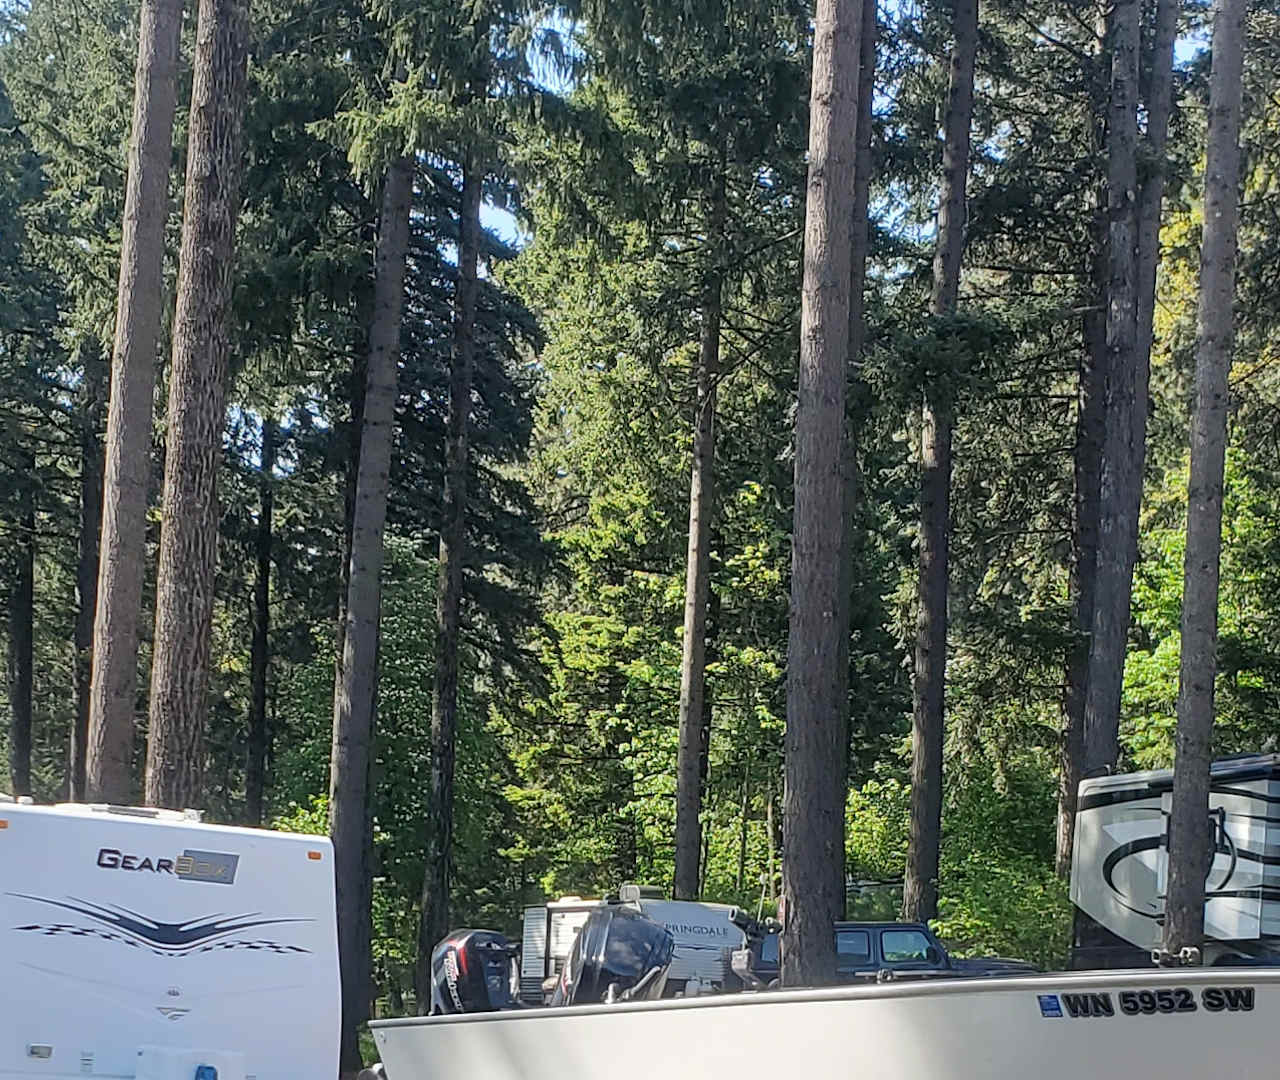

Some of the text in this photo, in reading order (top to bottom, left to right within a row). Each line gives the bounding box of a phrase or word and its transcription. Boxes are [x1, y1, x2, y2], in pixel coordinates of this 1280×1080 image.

[664, 922, 729, 937] PRINGDALE
[1061, 992, 1115, 1018] WN
[1118, 988, 1198, 1015] 5952
[1201, 986, 1256, 1012] SW
